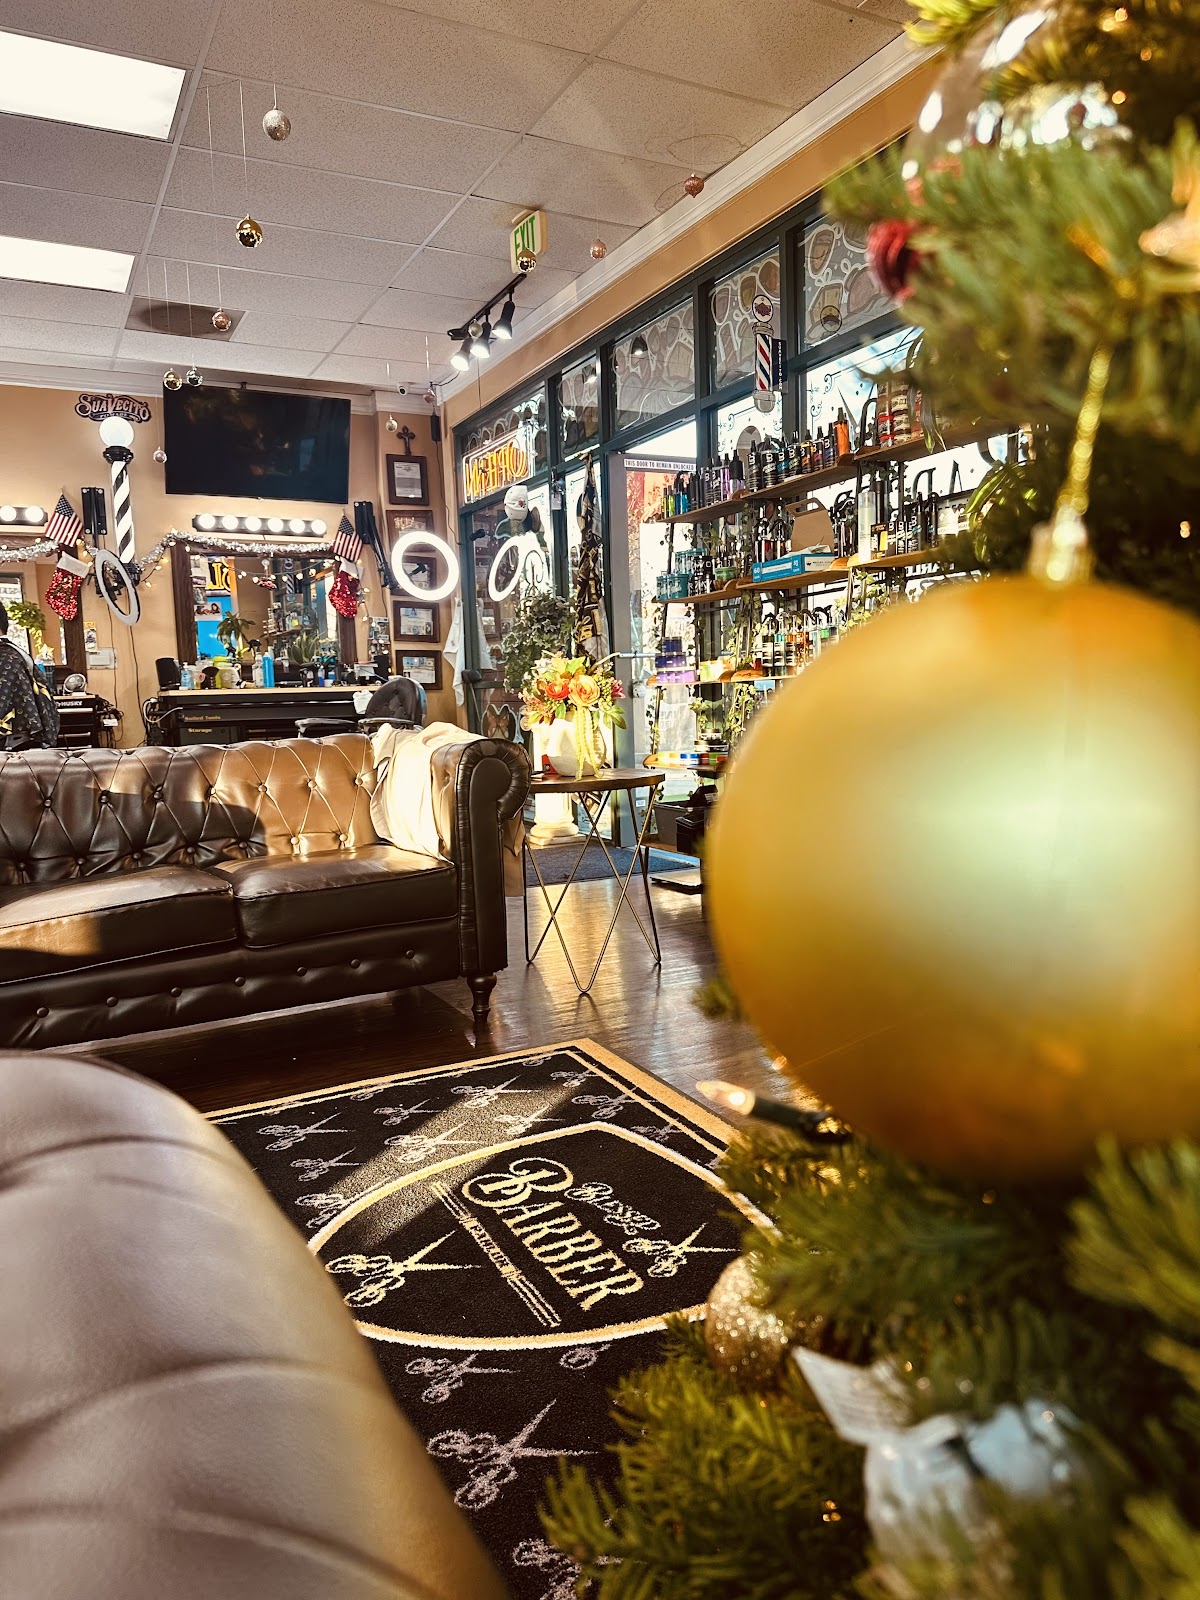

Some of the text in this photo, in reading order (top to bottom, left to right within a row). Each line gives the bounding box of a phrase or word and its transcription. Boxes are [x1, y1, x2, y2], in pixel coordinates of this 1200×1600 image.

[513, 215, 536, 266] EXIT
[672, 463, 694, 471] UNLOCKED
[462, 1157, 645, 1311] BARBER
